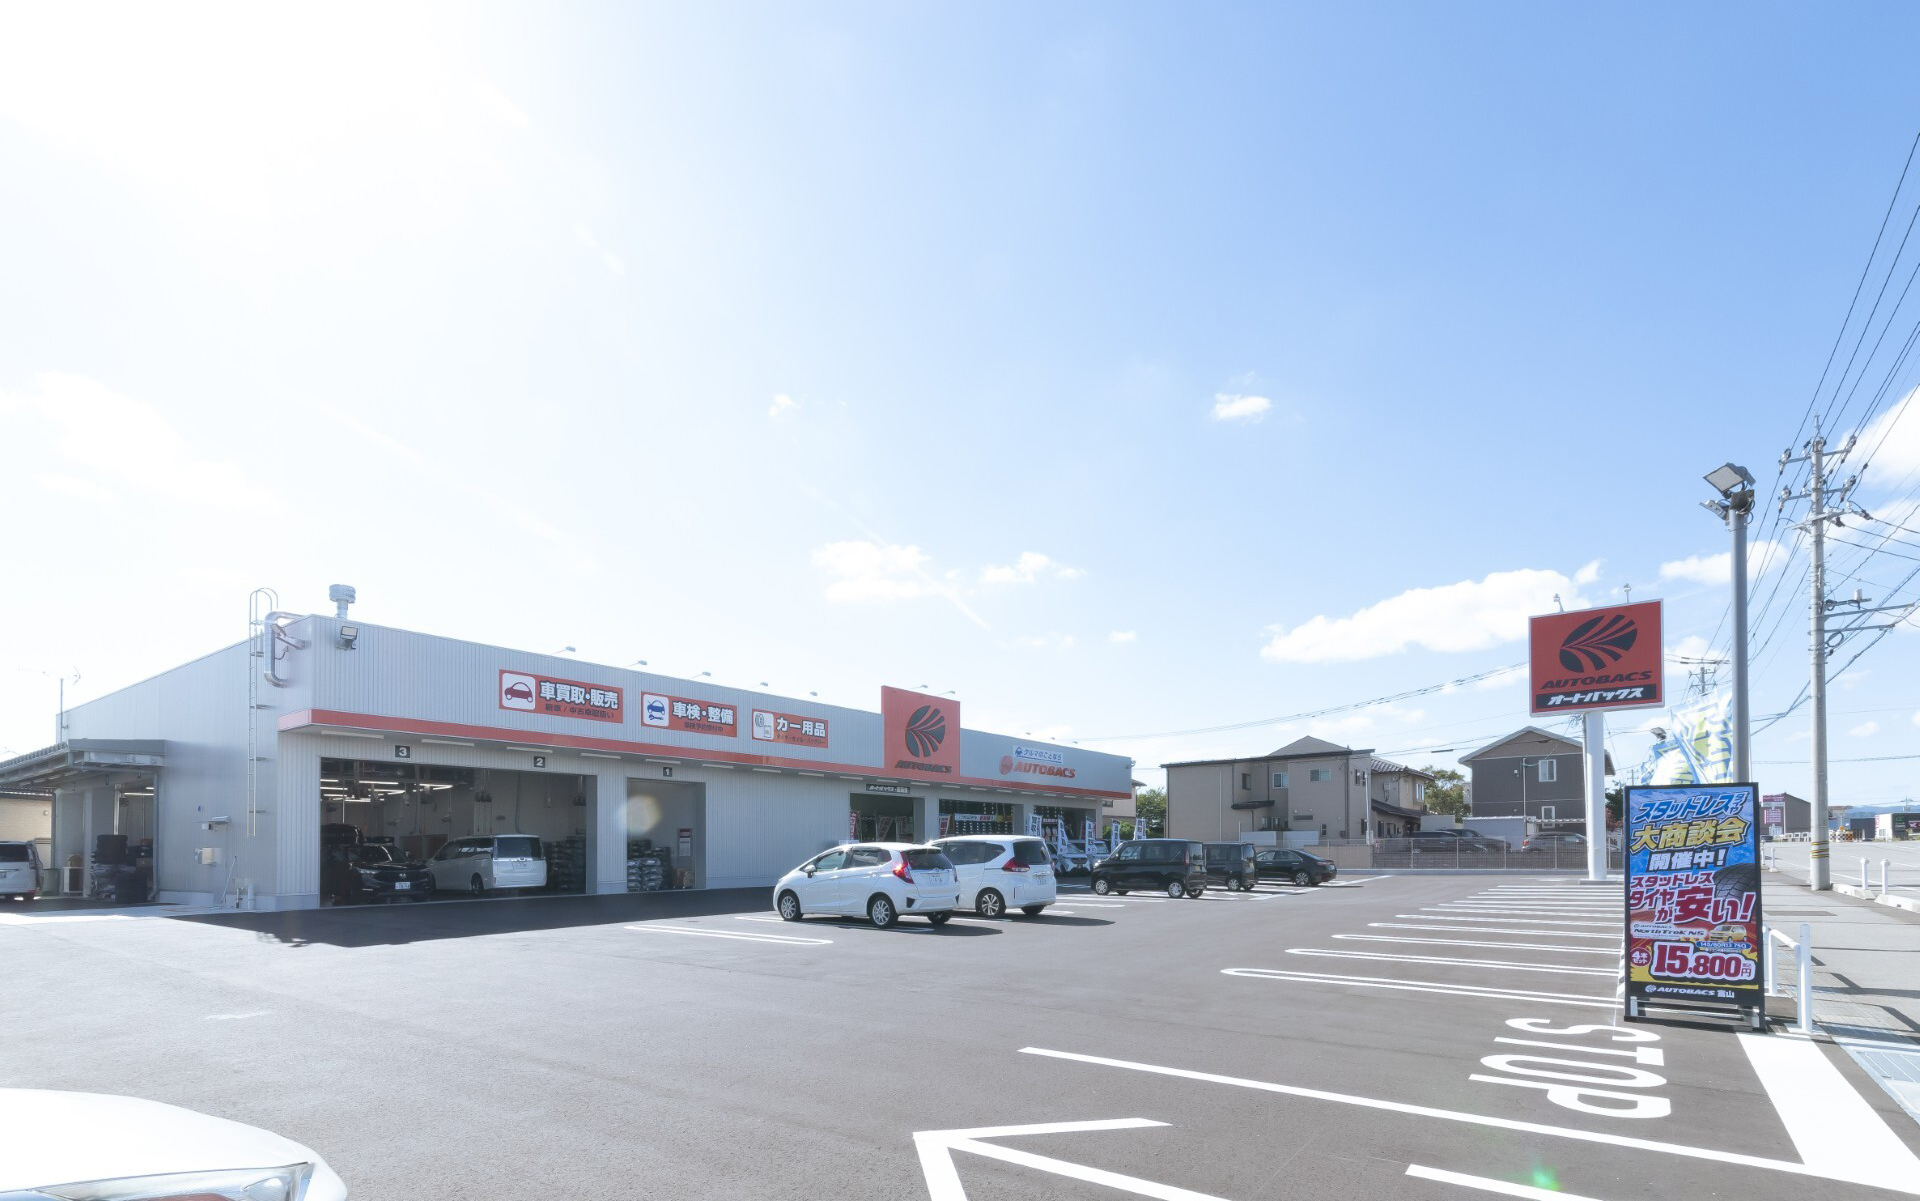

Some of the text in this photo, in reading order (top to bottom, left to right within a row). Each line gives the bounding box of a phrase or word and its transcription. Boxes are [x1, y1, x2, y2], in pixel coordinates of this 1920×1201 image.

[1541, 671, 1652, 689] AUTOBACS
[540, 682, 618, 709] 車買取・販売
[1548, 688, 1644, 705] オートバックス
[672, 702, 734, 724] 車検・整備
[776, 717, 826, 737] カー用品
[399, 747, 407, 756] 3
[1023, 748, 1062, 760] クルマのことなら
[536, 758, 543, 766] 2
[895, 760, 952, 773] AUTOBACS
[1013, 761, 1076, 778] AUTOBACS
[1633, 794, 1735, 821] スタッドレス
[1730, 792, 1747, 814] タイヤ
[1631, 816, 1746, 851] 大商談会
[1649, 849, 1726, 871] 開催中!
[1631, 872, 1714, 888] スタッドレス
[1630, 889, 1675, 907] タイヤ
[1673, 886, 1755, 923] 安い!
[1656, 907, 1673, 922] が
[1656, 987, 1735, 998] AUTOBACS 富山
[1468, 1018, 1671, 1118] STOP
